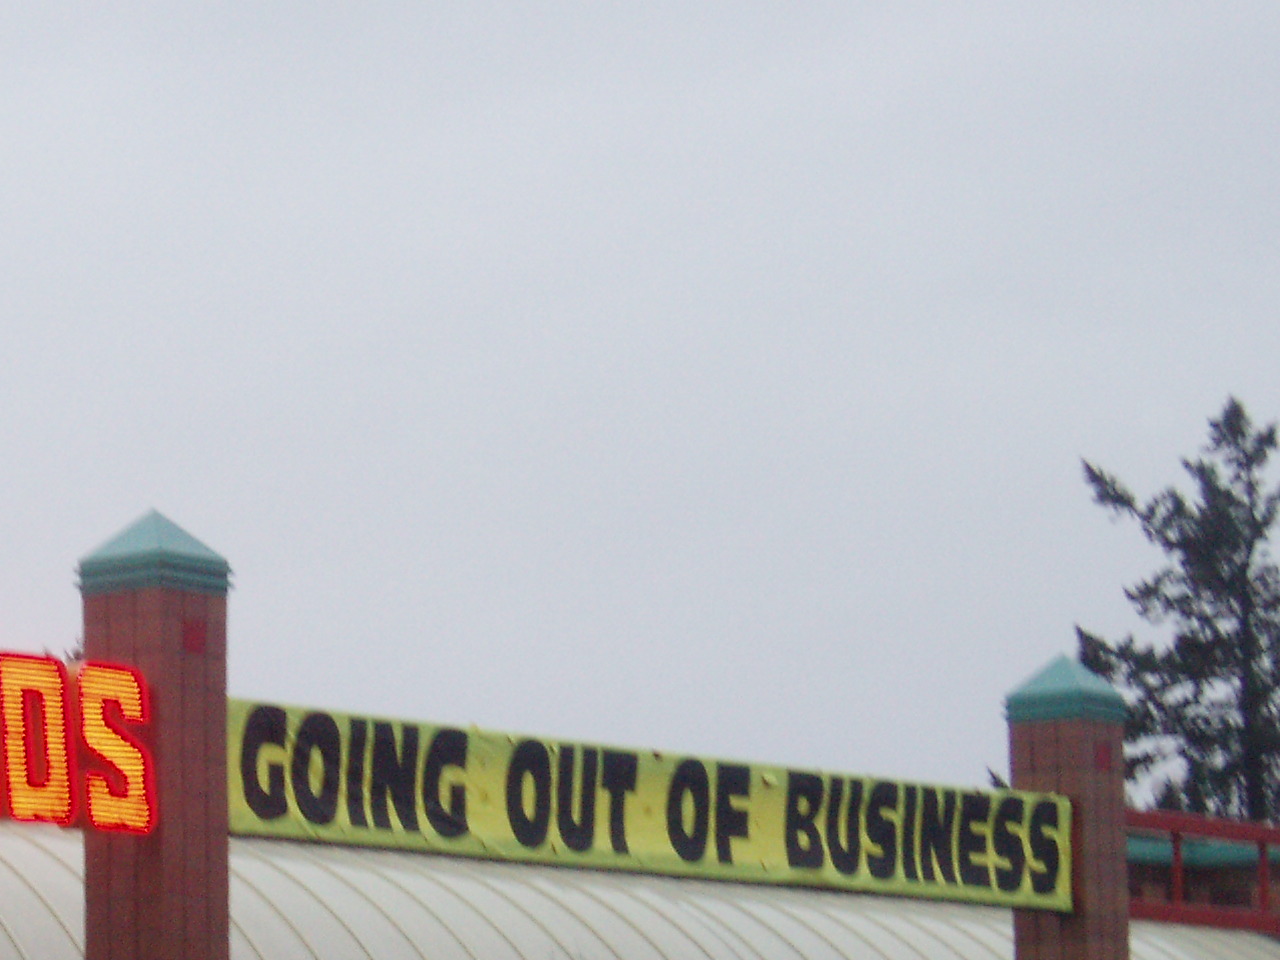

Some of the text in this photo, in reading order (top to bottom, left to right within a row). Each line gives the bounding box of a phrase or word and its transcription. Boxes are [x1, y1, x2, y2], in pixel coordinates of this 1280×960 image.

[239, 705, 1060, 894] GOING OUT OF BUSINESS
